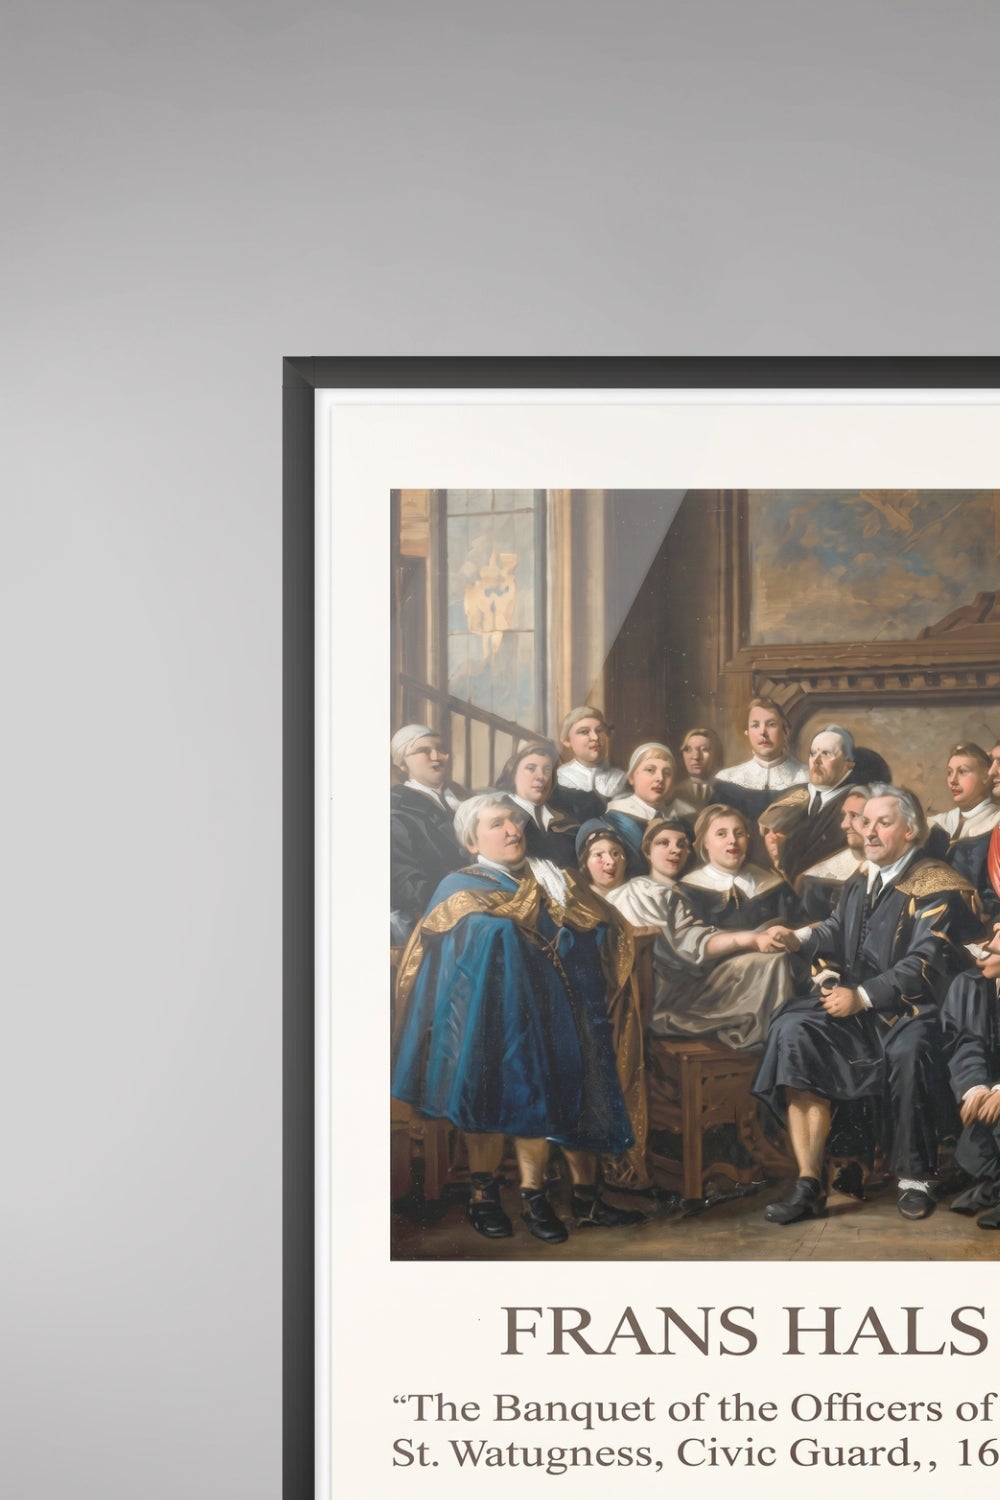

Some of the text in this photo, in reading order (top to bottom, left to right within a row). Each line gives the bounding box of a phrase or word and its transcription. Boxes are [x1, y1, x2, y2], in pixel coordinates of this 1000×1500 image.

[500, 1305, 989, 1357] FRANS HALS
[392, 1392, 481, 1422] “The
[493, 1393, 656, 1431] Banquet
[668, 1392, 711, 1422] of
[717, 1392, 778, 1422] the
[790, 1392, 943, 1422] Officers
[955, 1391, 999, 1422] of
[392, 1438, 439, 1468] St.
[448, 1439, 664, 1476] Watugness,
[677, 1436, 777, 1468] Civic
